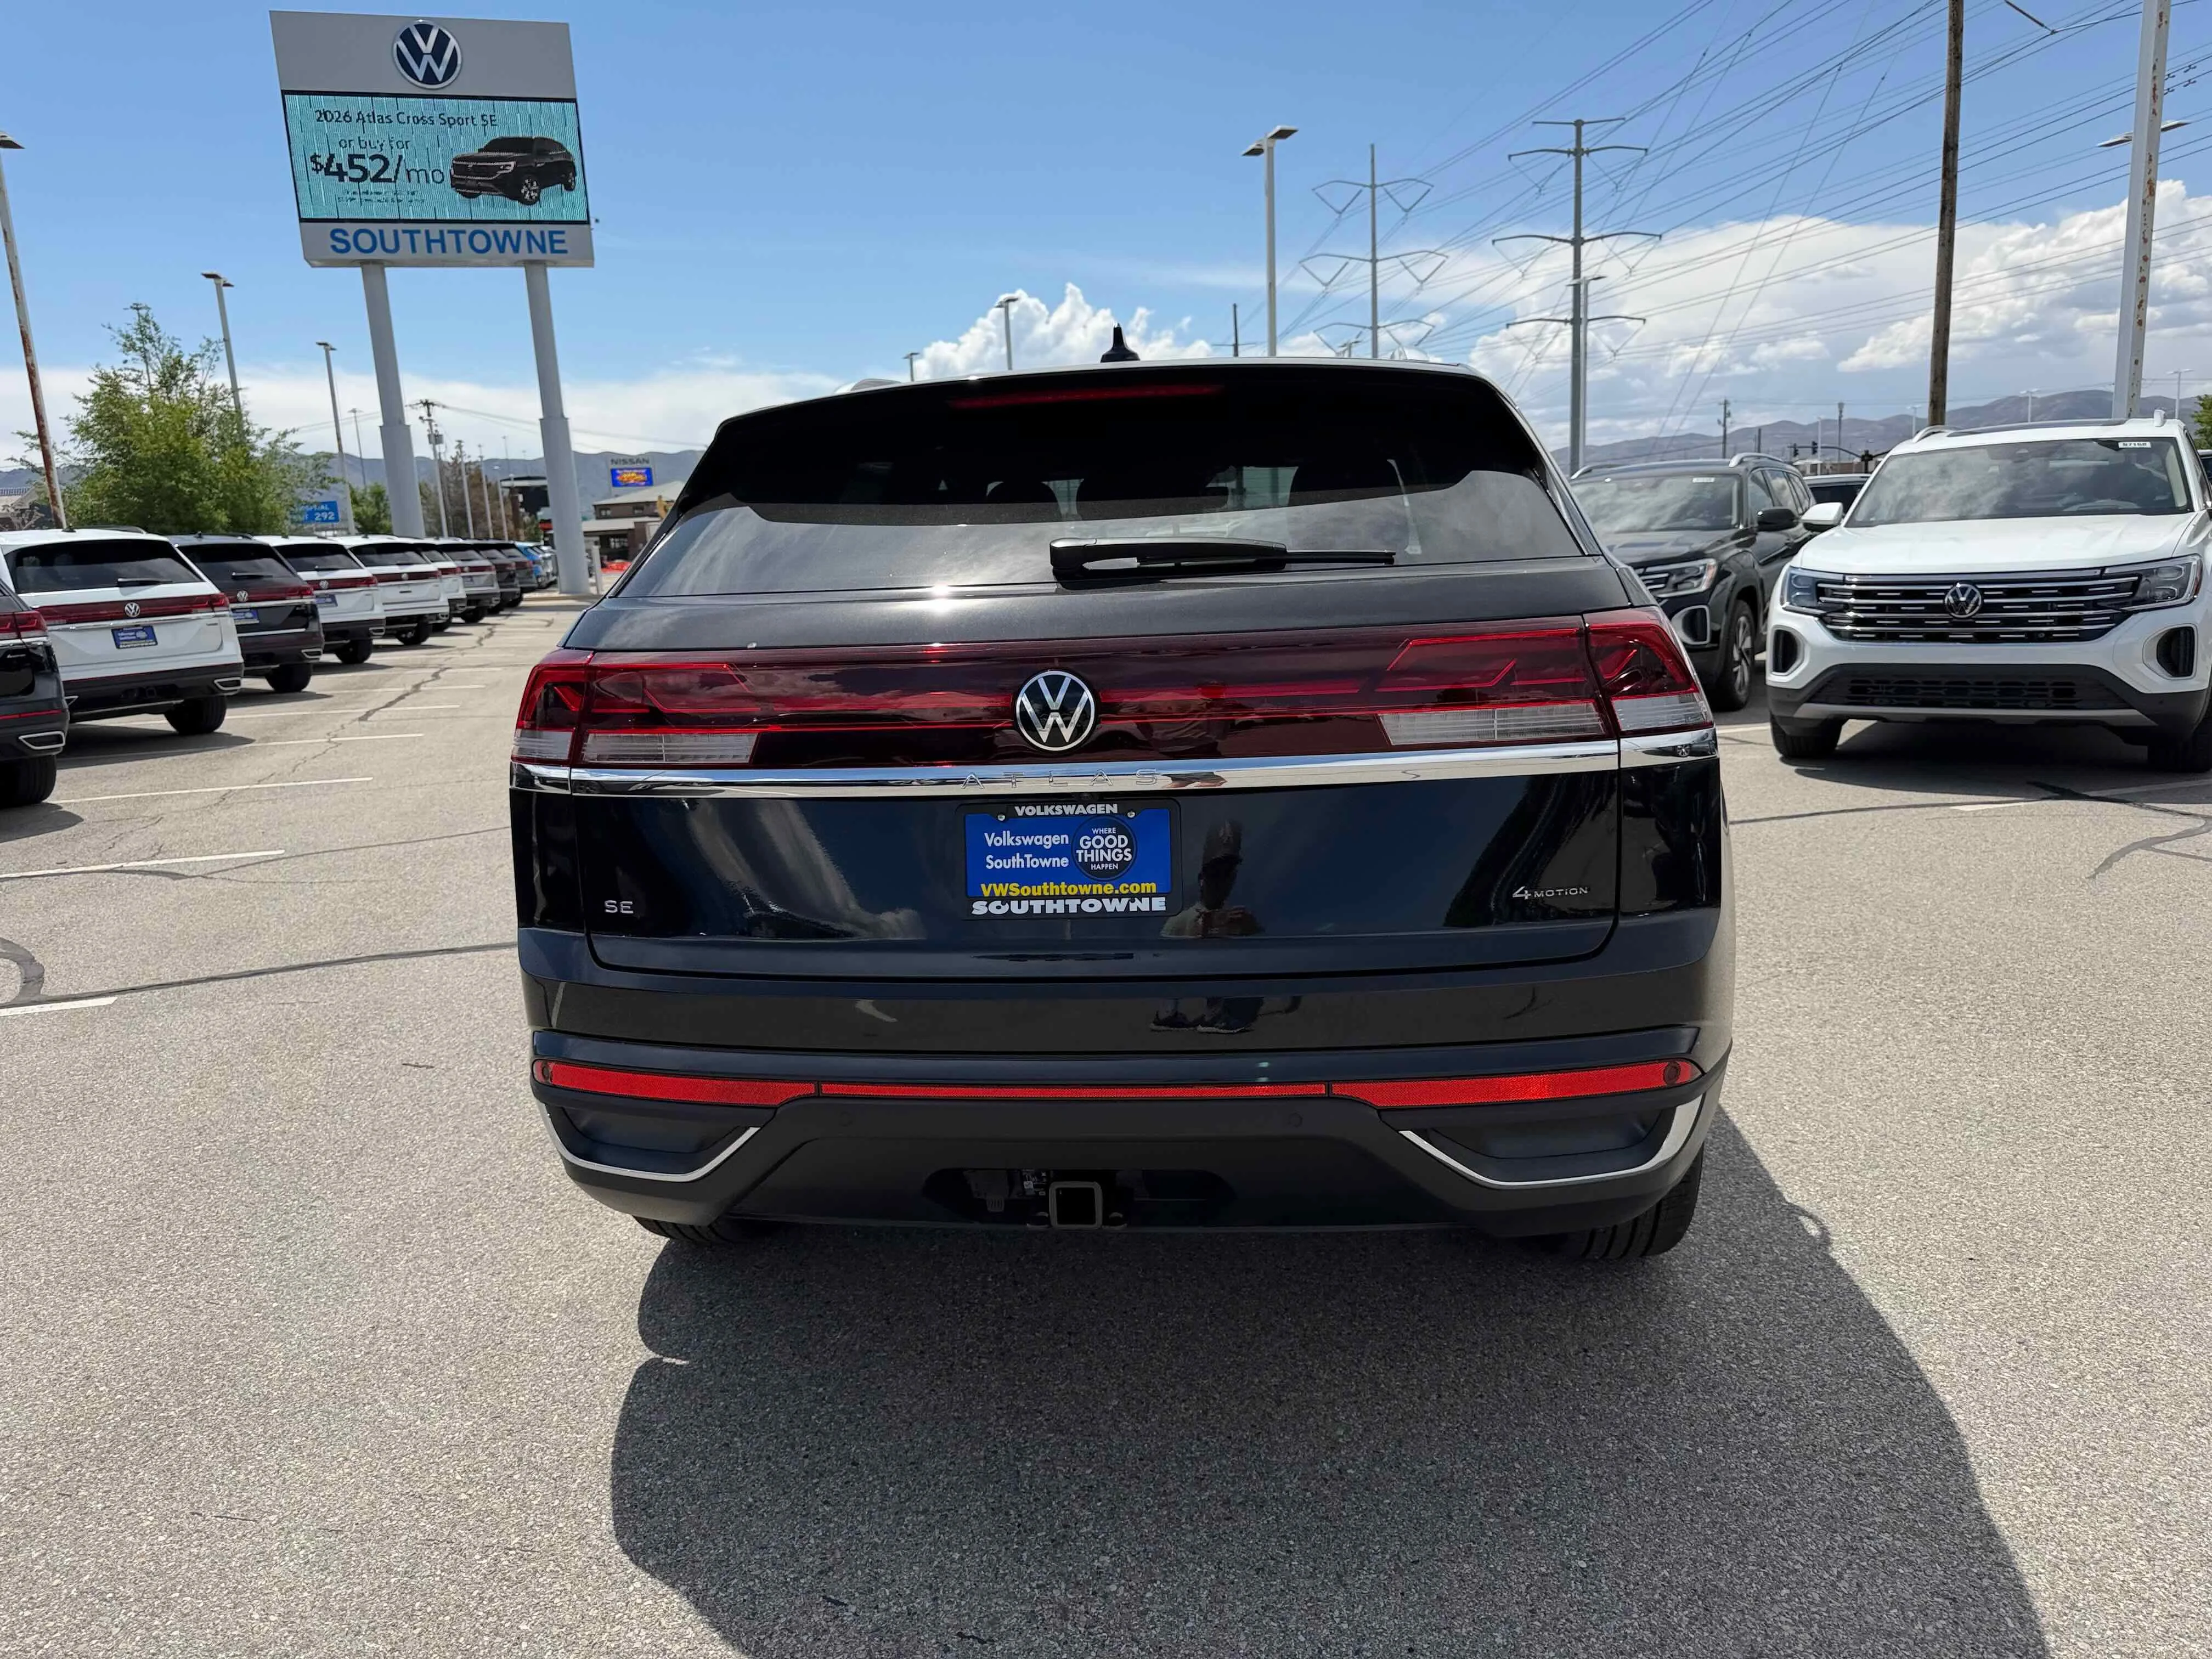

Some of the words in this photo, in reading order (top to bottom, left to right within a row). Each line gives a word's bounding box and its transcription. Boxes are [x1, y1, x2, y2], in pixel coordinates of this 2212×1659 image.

[393, 19, 462, 89] VW
[315, 109, 352, 123] 2026
[356, 110, 392, 125] Atlas
[397, 112, 435, 126] Cross
[438, 113, 476, 128] Sport
[481, 114, 498, 127] SE
[338, 138, 353, 149] or
[329, 228, 568, 254] SOUTHTOWNE
[314, 511, 335, 521] 292
[1015, 670, 1095, 752] VW
[961, 769, 1159, 789] ATLAS
[1014, 804, 1119, 816] VOLKSWAGEN
[984, 831, 1069, 849] Volkswagen
[1079, 835, 1128, 849] GOOD
[1076, 848, 1132, 862] THINGS
[981, 882, 1157, 897] VWSouthtowne.com
[605, 900, 633, 913] SE
[972, 896, 1166, 916] SOUTHTOWNE
